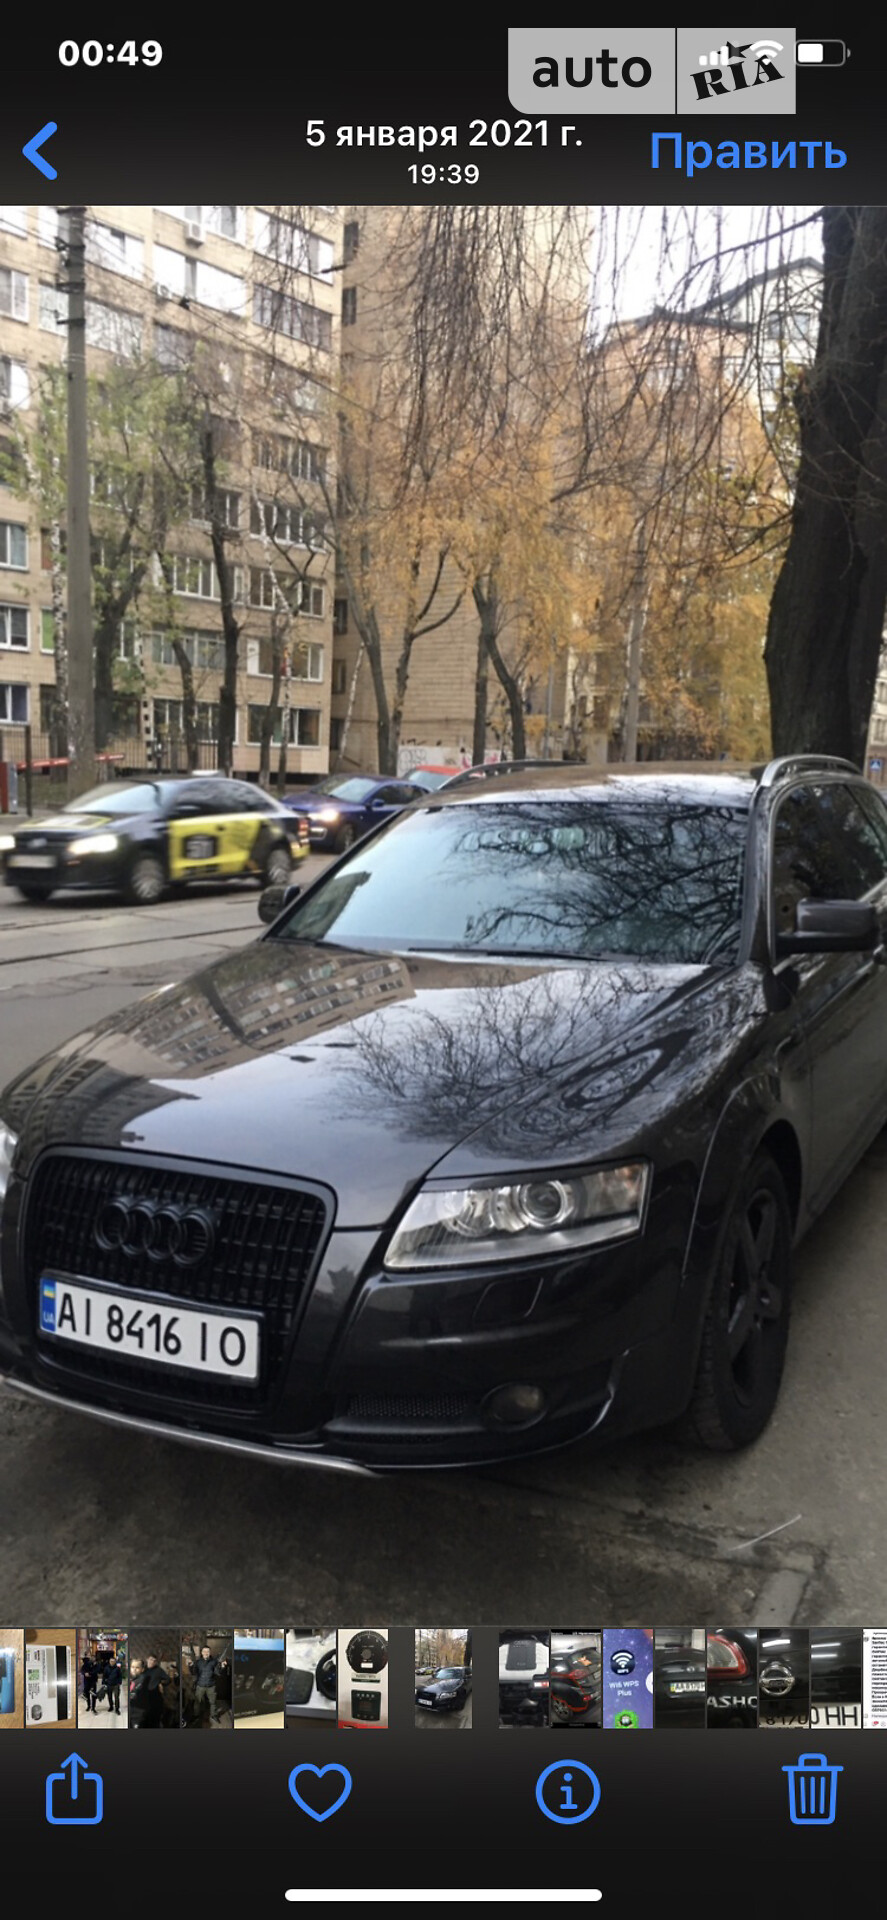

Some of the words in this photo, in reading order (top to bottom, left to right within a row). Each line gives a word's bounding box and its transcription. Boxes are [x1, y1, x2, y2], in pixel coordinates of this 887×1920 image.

[58, 39, 163, 67] 00:49
[306, 120, 326, 147] 5
[335, 125, 458, 153] января
[468, 120, 548, 147] 2021
[561, 125, 583, 147] г.
[651, 132, 848, 178] Править
[407, 163, 480, 185] 19:39
[43, 1310, 56, 1324] UA
[106, 1303, 182, 1356] 8416
[617, 1689, 633, 1697] Plus
